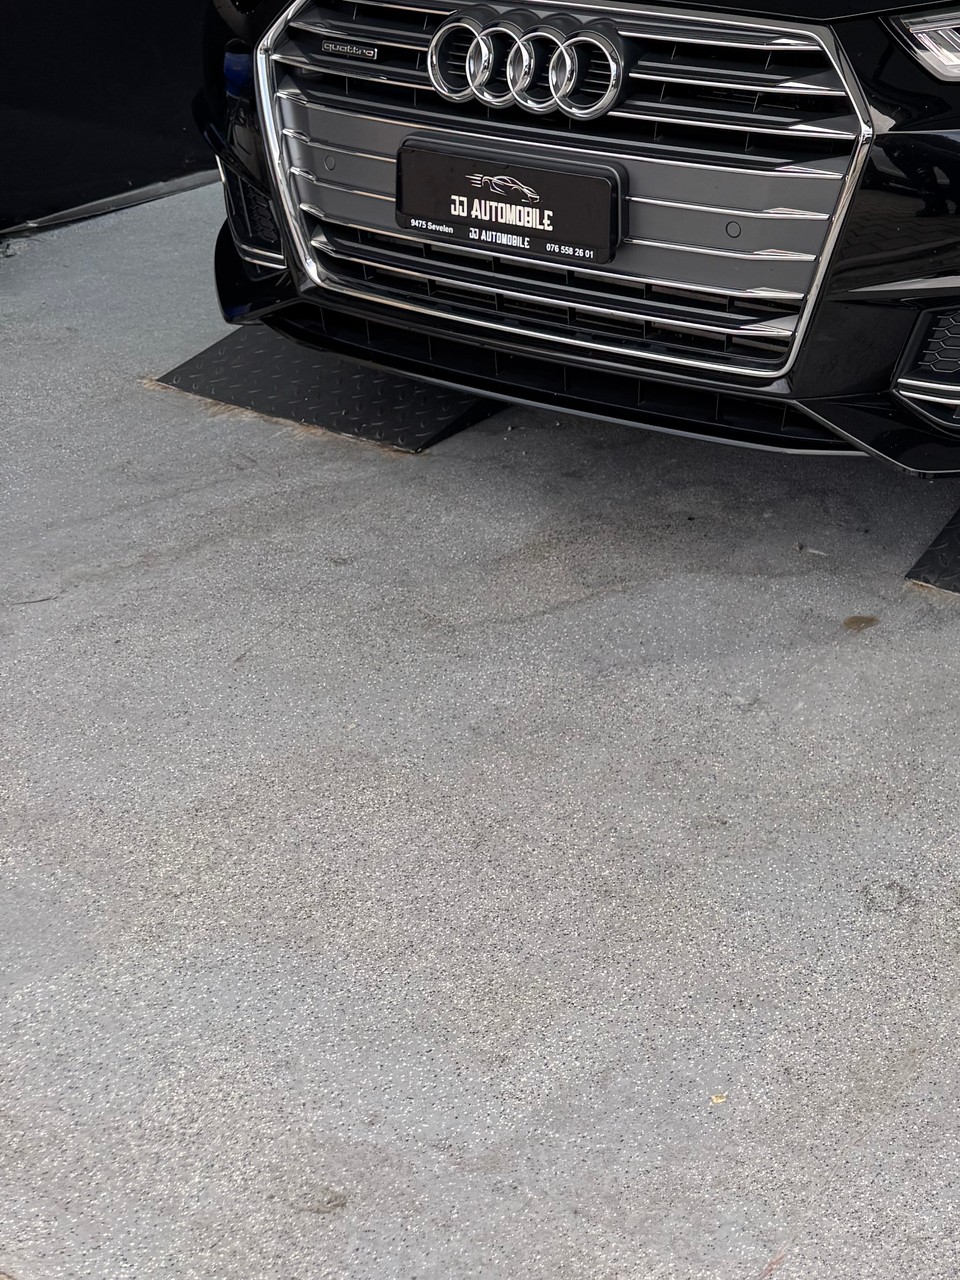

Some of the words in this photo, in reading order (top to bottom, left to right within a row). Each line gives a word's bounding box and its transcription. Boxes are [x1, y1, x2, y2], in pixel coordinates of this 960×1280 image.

[323, 43, 374, 57] quattro
[450, 195, 467, 217] JJ
[471, 198, 553, 231] AUTOMOBILE
[410, 218, 427, 229] 9475
[427, 221, 454, 234] Sevelen
[469, 227, 479, 240] JJ
[480, 229, 530, 248] AUTOMOBILE
[546, 243, 560, 253] 076
[560, 245, 574, 255] 558
[574, 247, 584, 257] 26
[585, 249, 594, 259] 01
